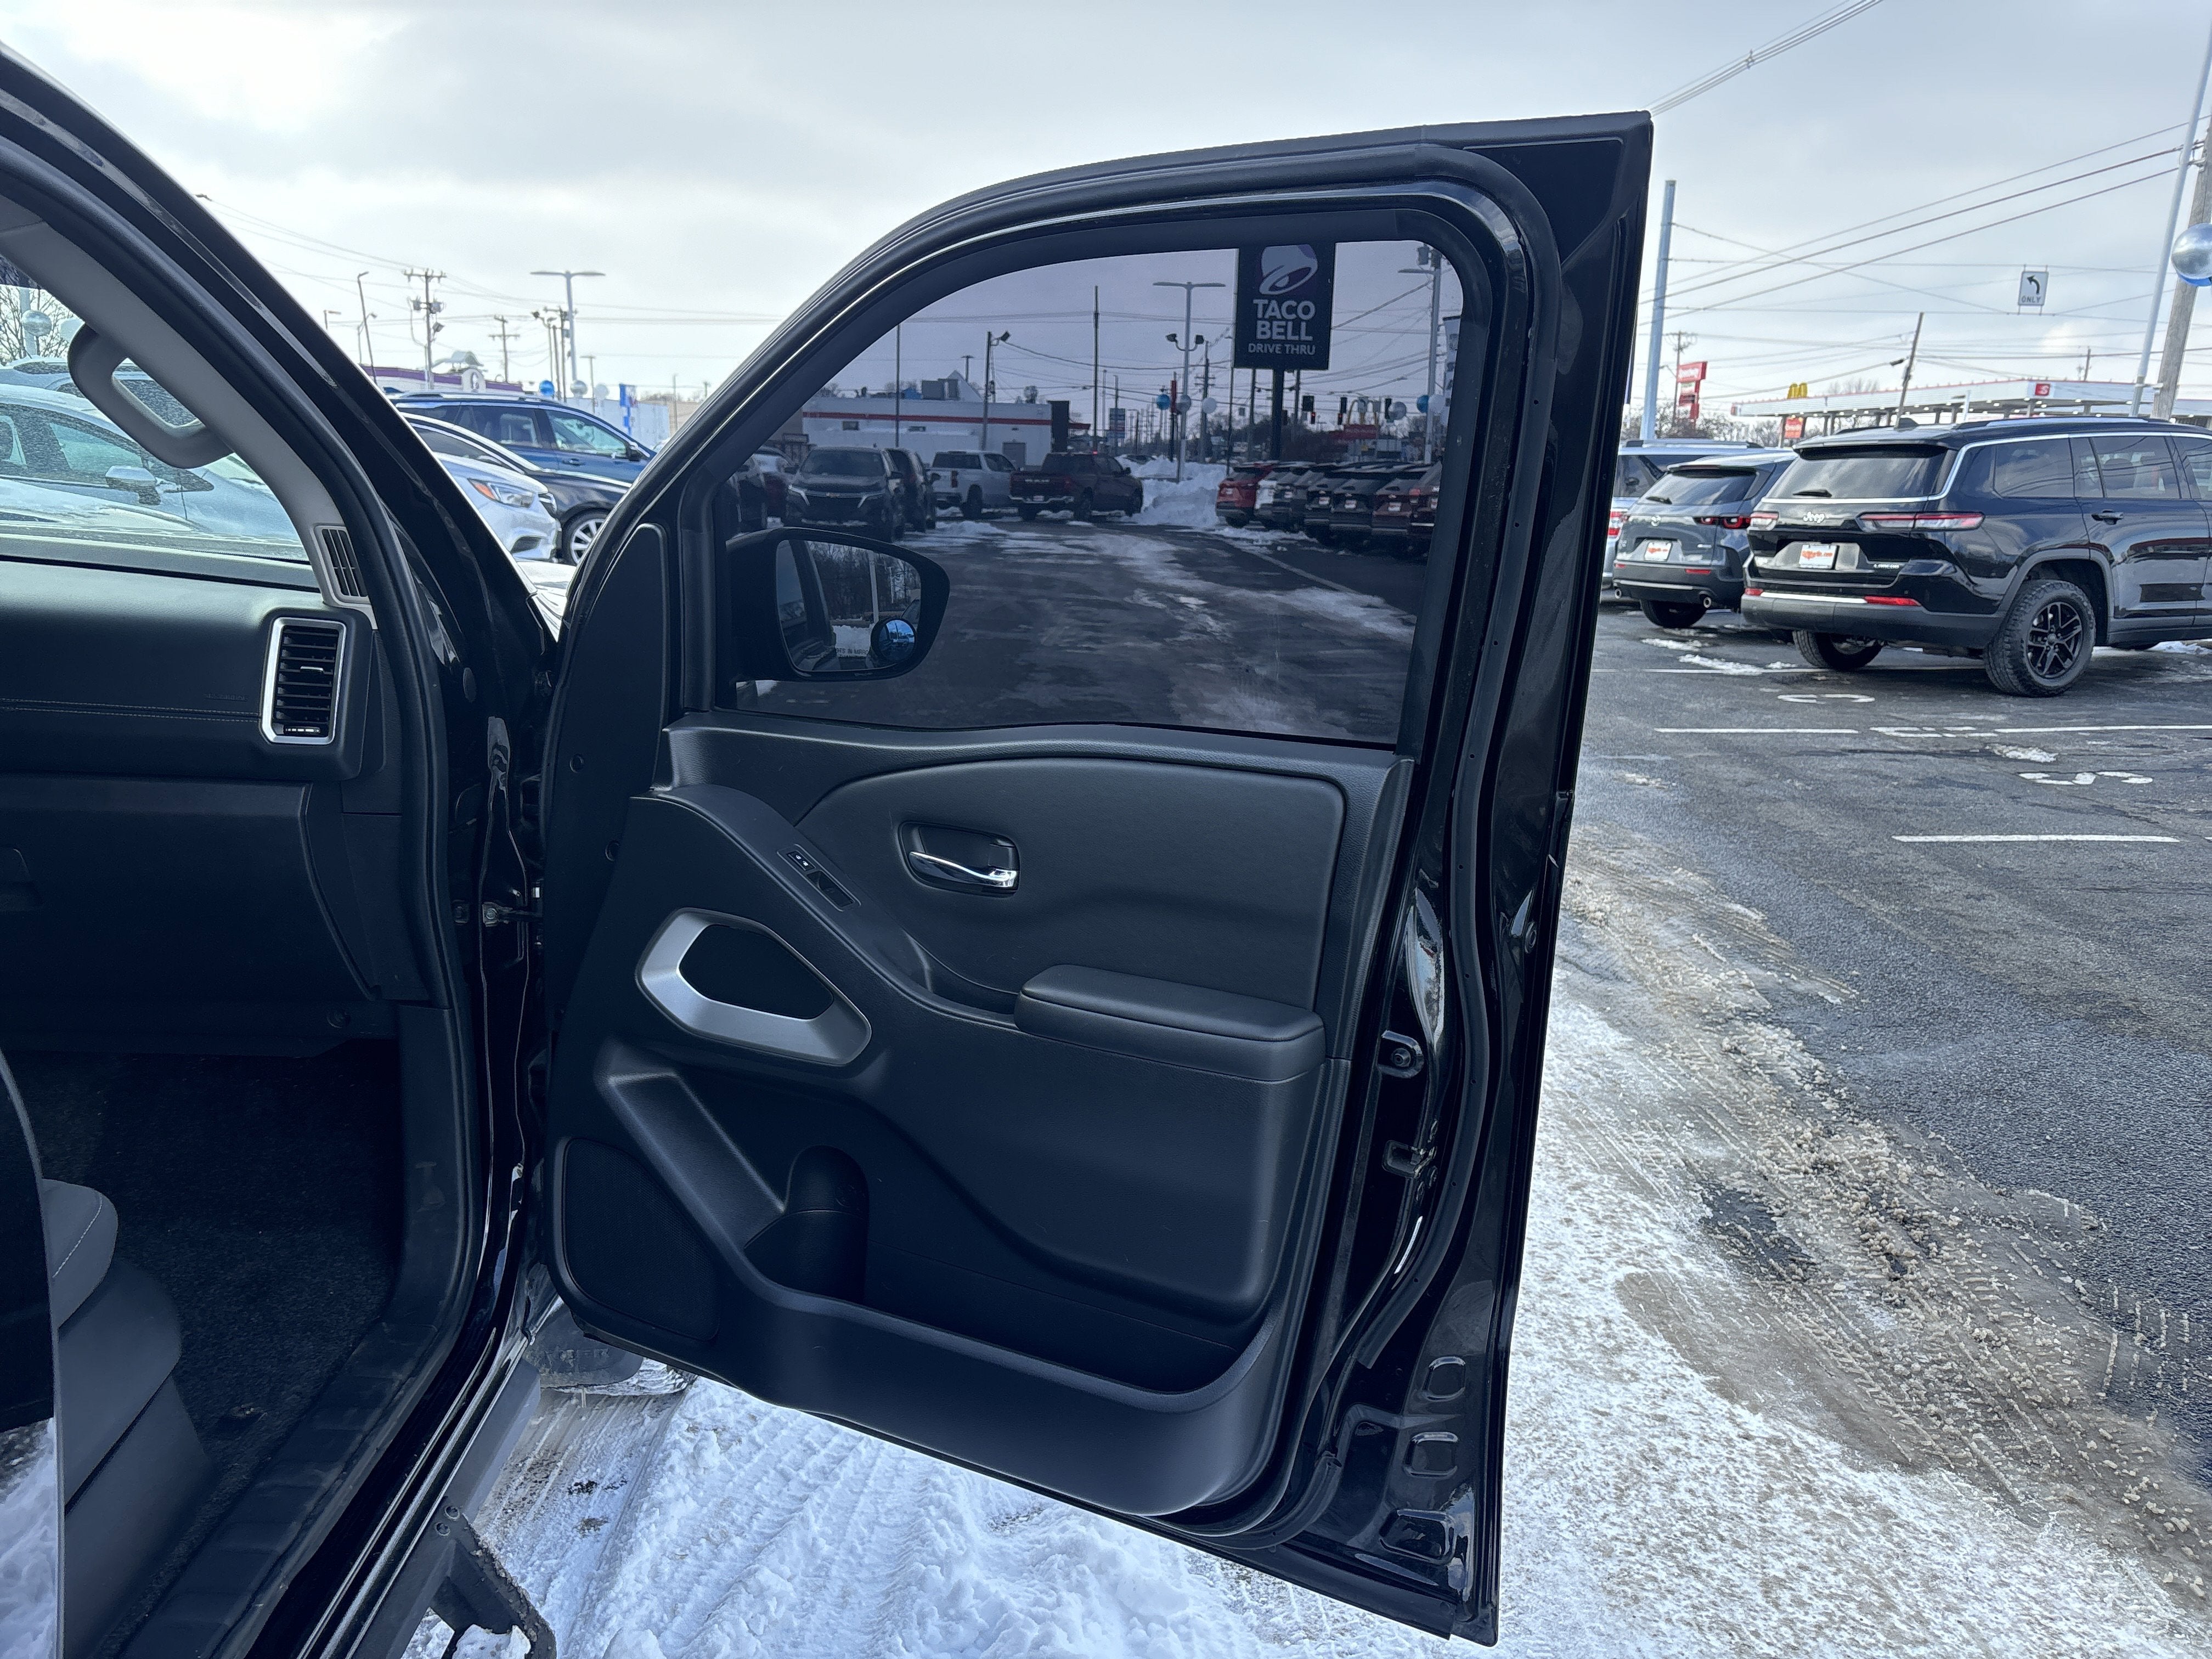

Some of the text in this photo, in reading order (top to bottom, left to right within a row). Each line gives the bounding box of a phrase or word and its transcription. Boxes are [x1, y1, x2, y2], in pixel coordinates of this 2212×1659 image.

[2021, 295, 2041, 303] ONLY
[1252, 299, 1316, 320] TACO
[1256, 320, 1313, 341] BELL
[1248, 343, 1316, 355] DRIVE THRU
[1803, 511, 1825, 523] Jeep
